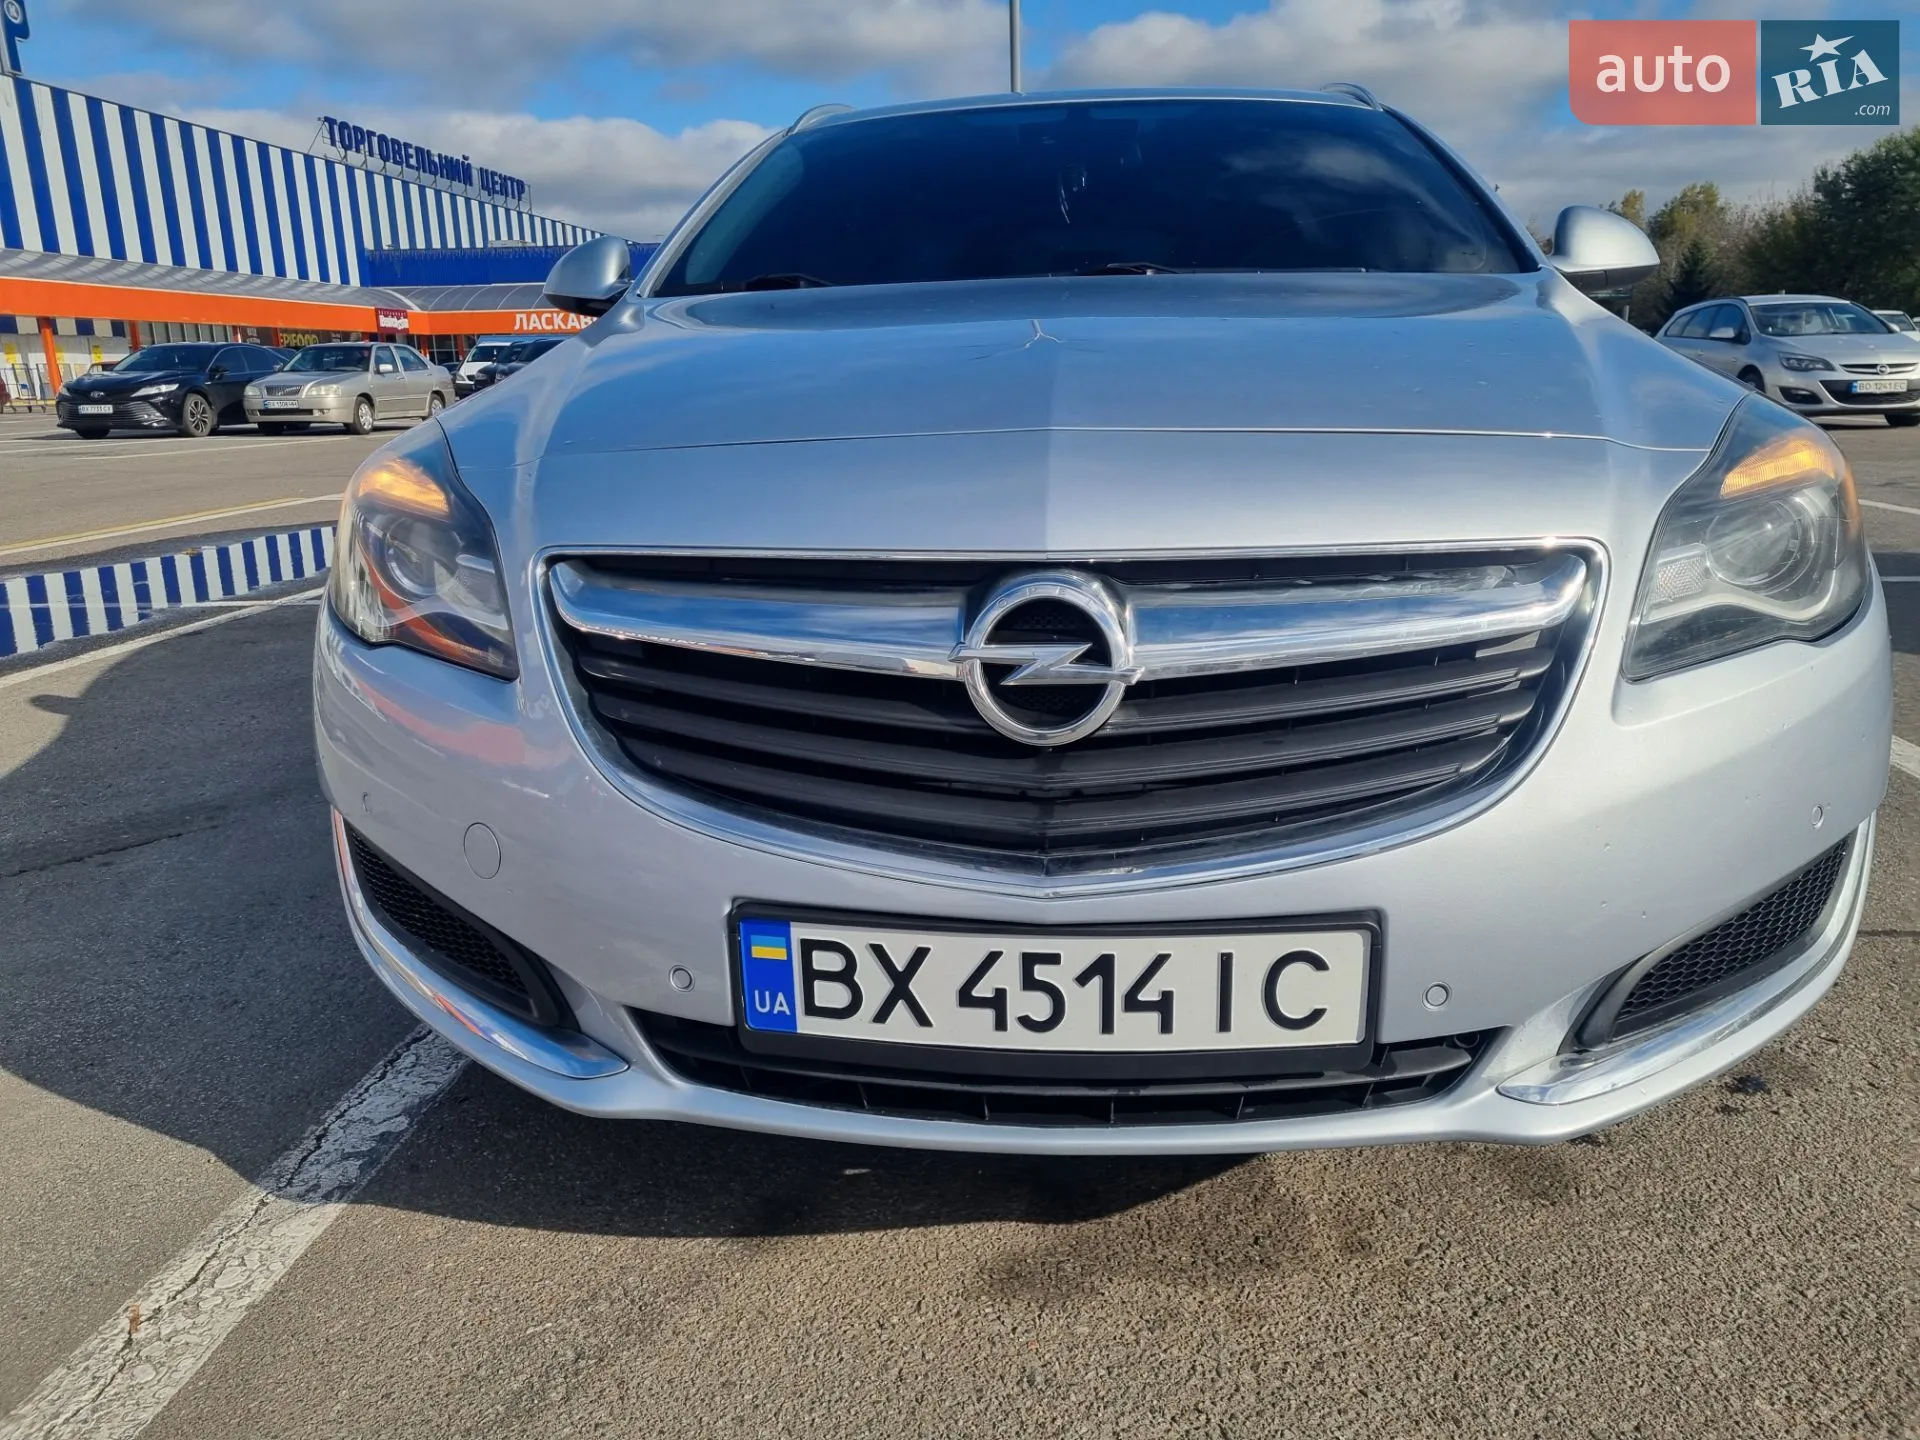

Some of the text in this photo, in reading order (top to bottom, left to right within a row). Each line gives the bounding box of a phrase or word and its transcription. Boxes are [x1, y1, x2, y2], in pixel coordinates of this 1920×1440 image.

[323, 116, 526, 200] ТОРГОВЕЛЬНИЙ ЦЕНТР
[513, 312, 599, 331] ЛАСКАВ
[753, 990, 791, 1016] UA
[799, 938, 934, 1028] BX
[956, 950, 1175, 1035] 4514
